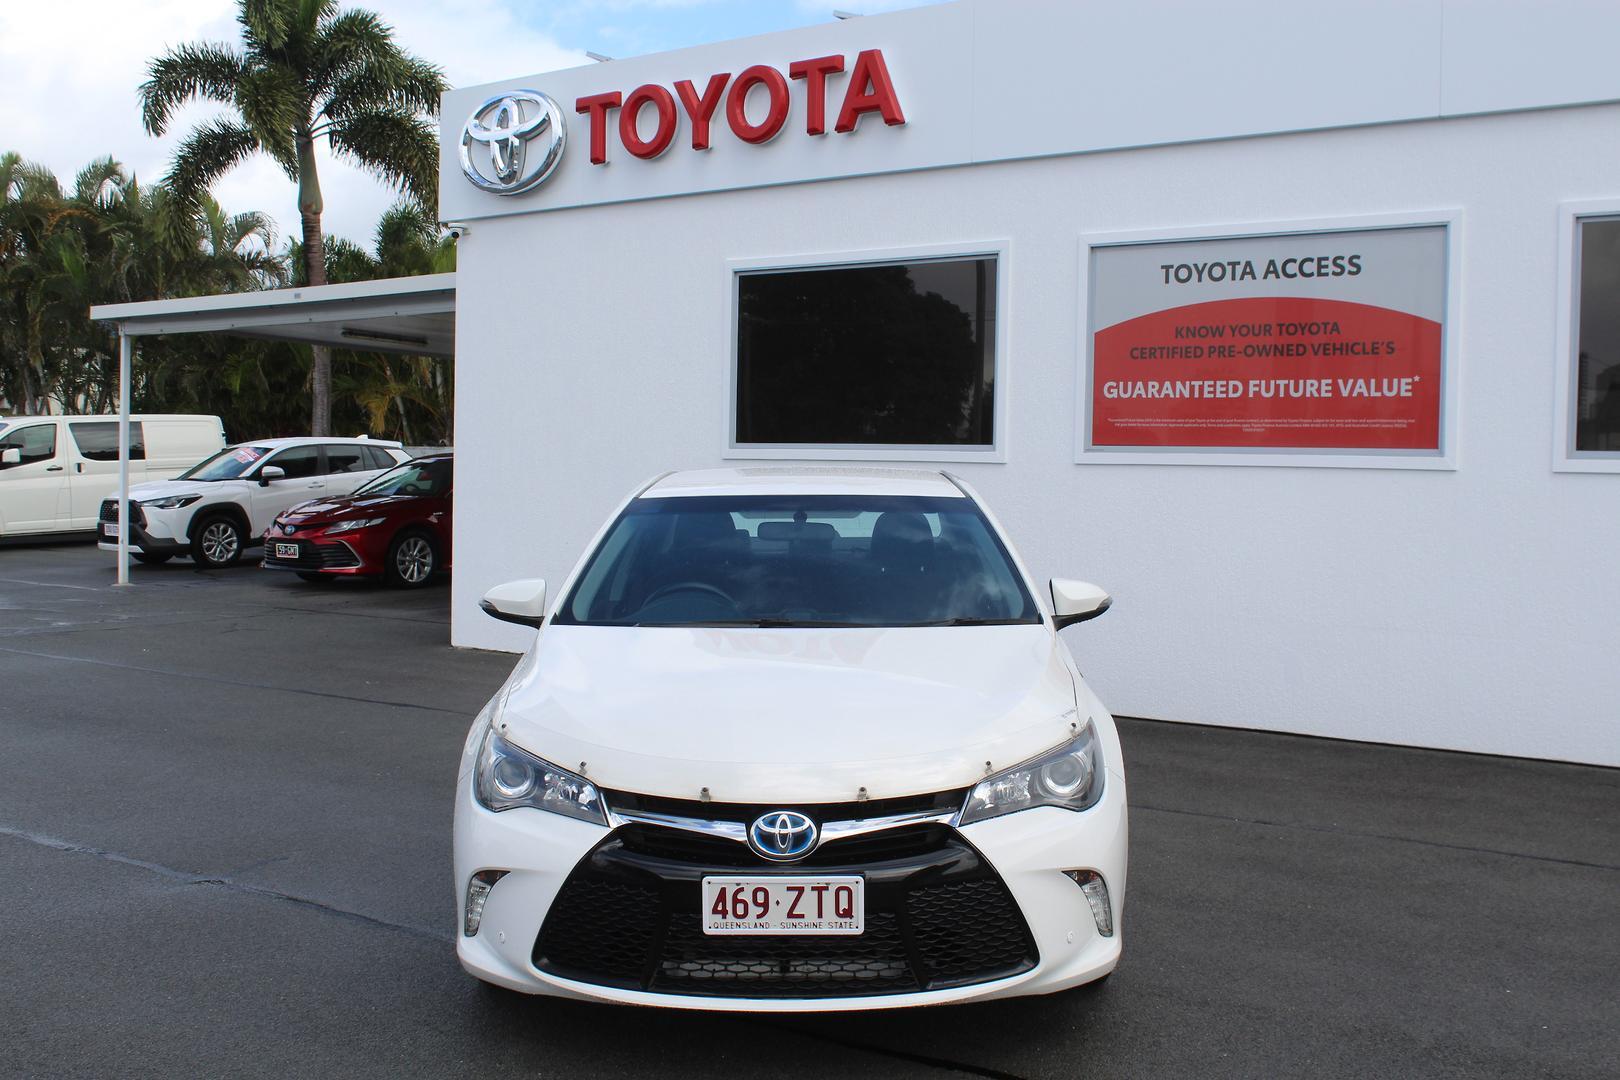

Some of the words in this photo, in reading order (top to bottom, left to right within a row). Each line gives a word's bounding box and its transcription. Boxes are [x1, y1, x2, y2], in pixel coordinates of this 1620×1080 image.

[576, 49, 906, 165] TOYOTA
[1161, 260, 1257, 284] TOYOTA
[1263, 255, 1362, 280] ACCESS
[1175, 325, 1225, 339] KNOW
[1229, 324, 1273, 338] YOUR
[1276, 322, 1341, 337] TOYOTA
[1130, 345, 1204, 360] CERTIFIED
[1208, 343, 1308, 359] PRE-OWNED
[1311, 341, 1396, 357] VEHICLE'S
[1103, 380, 1244, 399] GUARANTEED
[1248, 379, 1333, 398] FUTURE
[713, 922, 770, 930] QUEENSLAND
[780, 922, 823, 930] SUNSHINE
[828, 922, 854, 930] STATE
